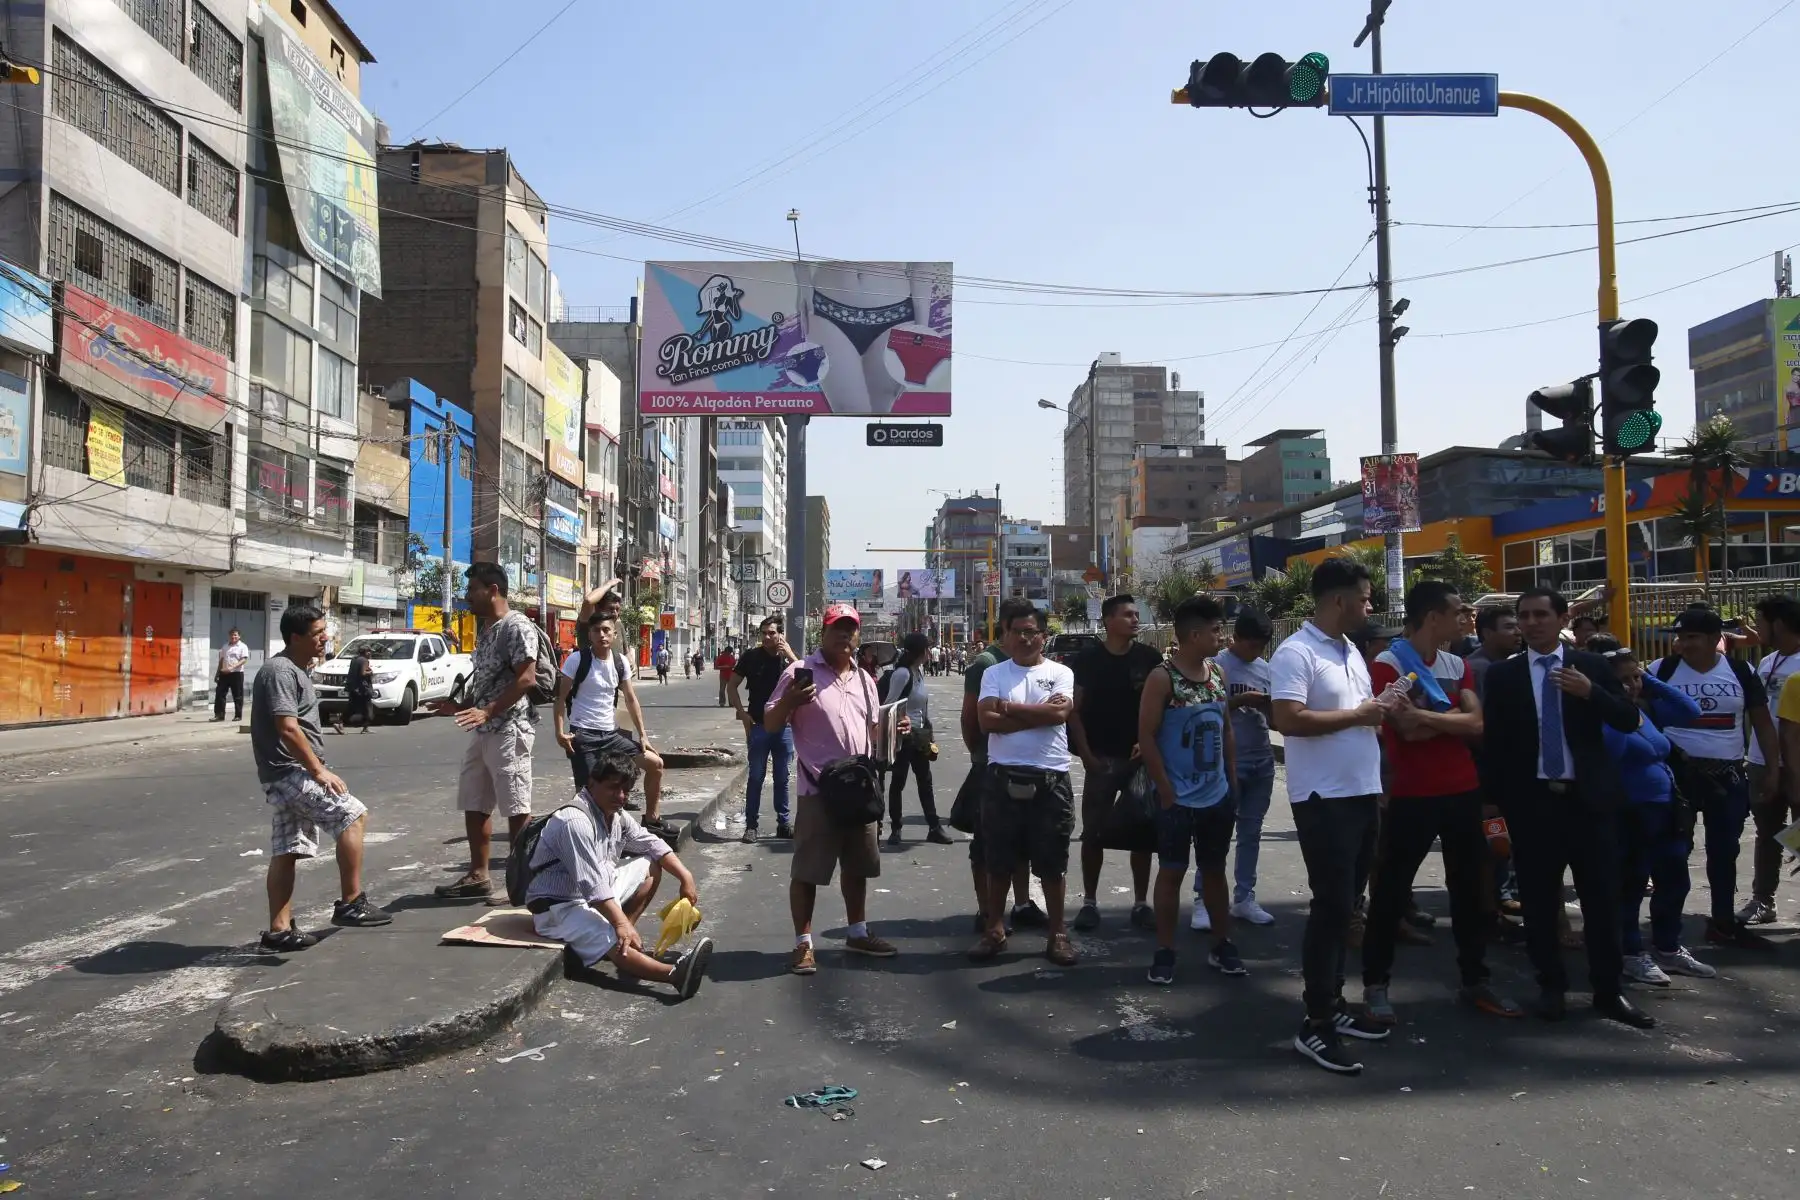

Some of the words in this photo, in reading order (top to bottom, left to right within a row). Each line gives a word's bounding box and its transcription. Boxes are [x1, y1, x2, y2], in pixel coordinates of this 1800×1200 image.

[658, 326, 779, 375] Rommy
[670, 373, 688, 383] Tan
[689, 368, 709, 378] Fina
[711, 358, 740, 372] como
[743, 353, 753, 363] Tú
[651, 396, 689, 408] 100%
[693, 395, 751, 411] Algodón
[755, 396, 814, 408] Peruano
[719, 422, 731, 430] LA
[734, 422, 761, 430] PERLA
[890, 428, 934, 439] Dardos
[1364, 481, 1376, 494] 31
[771, 587, 787, 597] 30
[427, 675, 445, 686] POLICIA
[1671, 683, 1744, 697] UCXI
